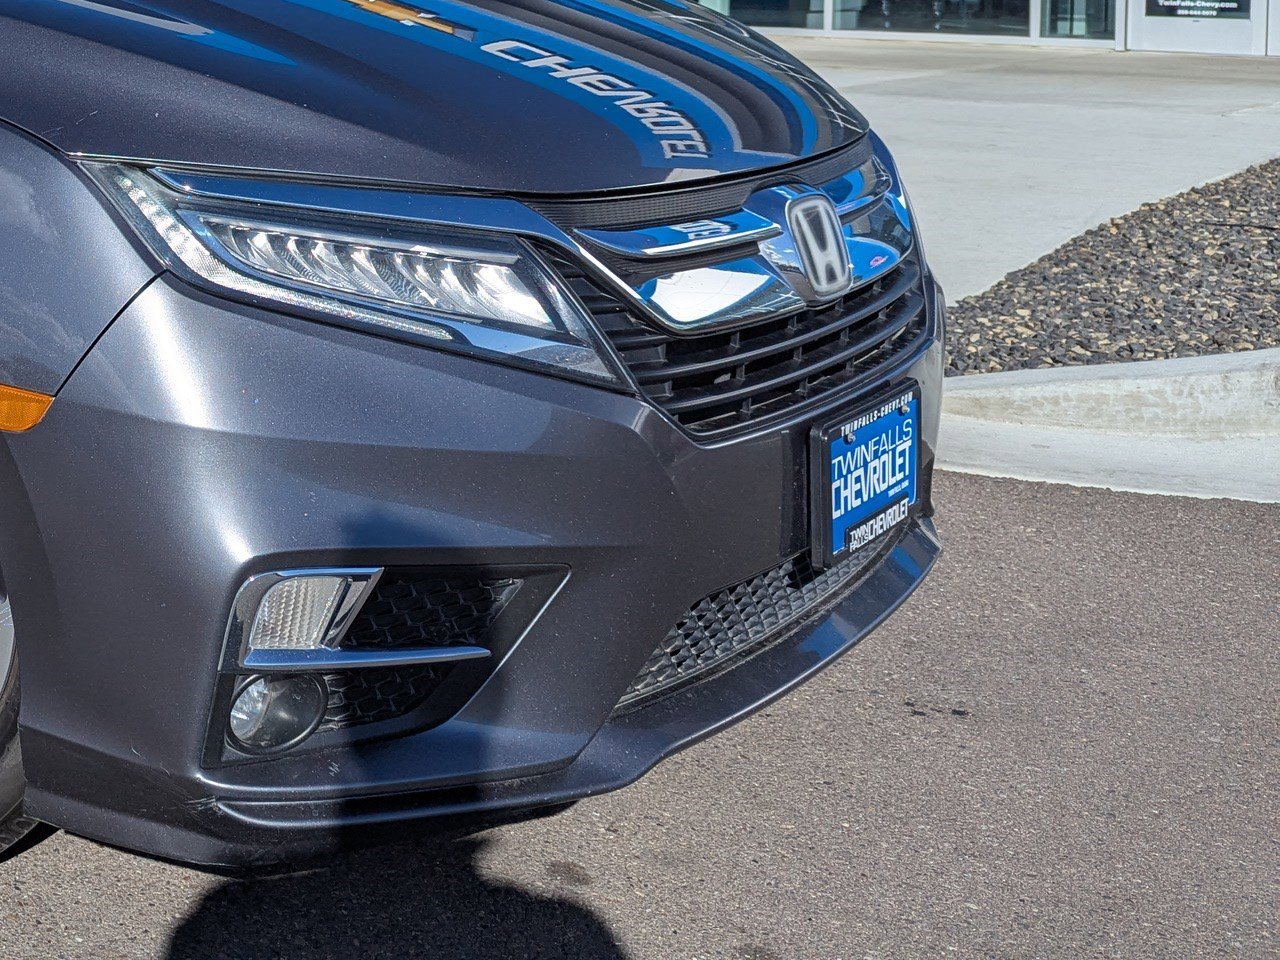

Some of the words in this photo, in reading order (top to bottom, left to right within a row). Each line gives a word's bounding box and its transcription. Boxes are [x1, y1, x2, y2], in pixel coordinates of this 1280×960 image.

[841, 391, 913, 437] TWINFALLS-CHEVY.COM
[832, 419, 912, 480] TWINFALLS
[832, 439, 912, 520] CHEVROLET
[850, 524, 869, 542] TWIN
[868, 497, 910, 540] CHEVROLET
[849, 533, 869, 552] FALLS
